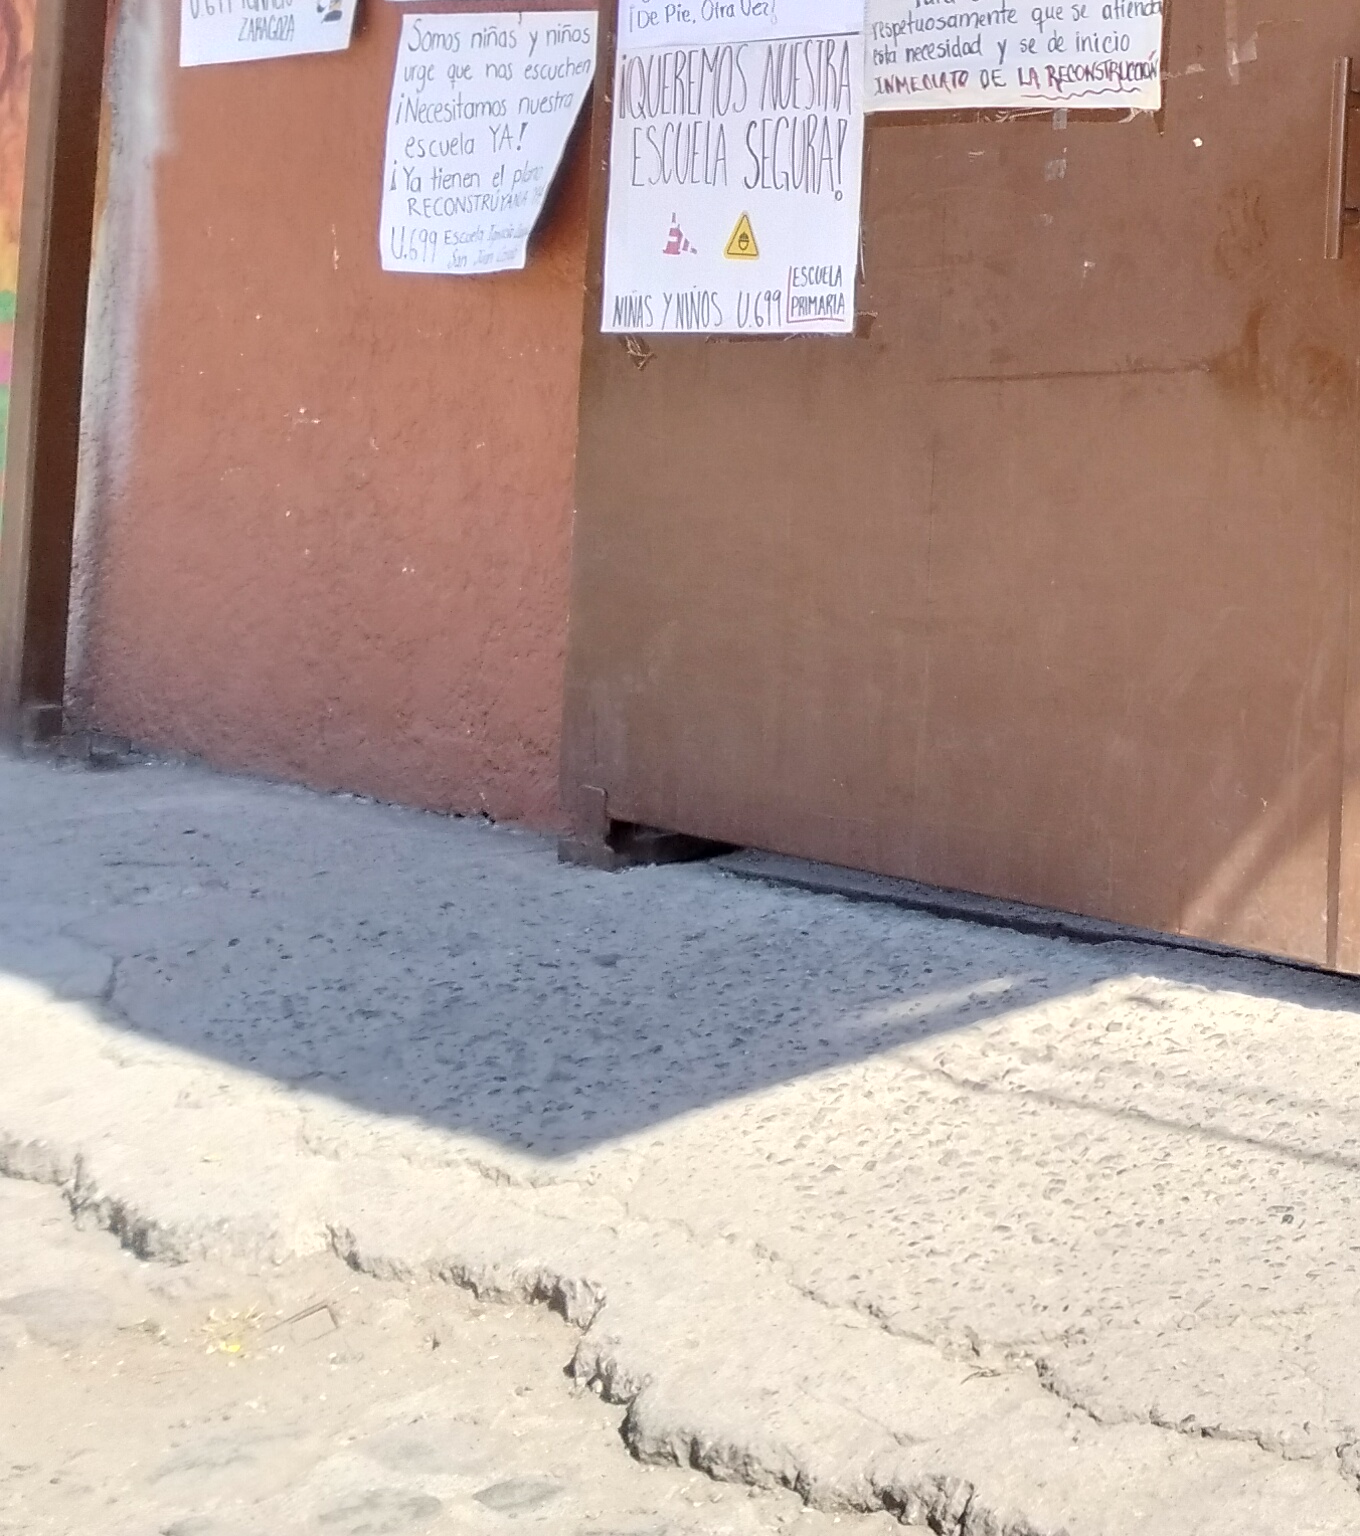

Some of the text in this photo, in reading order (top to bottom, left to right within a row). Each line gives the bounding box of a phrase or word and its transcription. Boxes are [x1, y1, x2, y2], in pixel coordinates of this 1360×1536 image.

[702, 0, 735, 22] Otra
[238, 15, 295, 42] ZARAGOZA
[407, 18, 460, 53] Somos
[471, 26, 516, 49] niñas
[546, 23, 591, 46] niños
[620, 38, 852, 119] ¡QUEREMOS NUESTRA
[980, 69, 1006, 88] DE
[1019, 65, 1040, 89] LA
[396, 91, 574, 125] ¡Necesitamos nuestra
[404, 122, 528, 158] escuela YA!
[632, 114, 848, 201] ESCUELA SEGURA!
[792, 266, 842, 287] ESCUELA
[612, 290, 652, 328] NIÑAS
[662, 292, 672, 330] Y
[676, 286, 723, 330] NIÑOS
[790, 294, 845, 316] PRIMARIA
